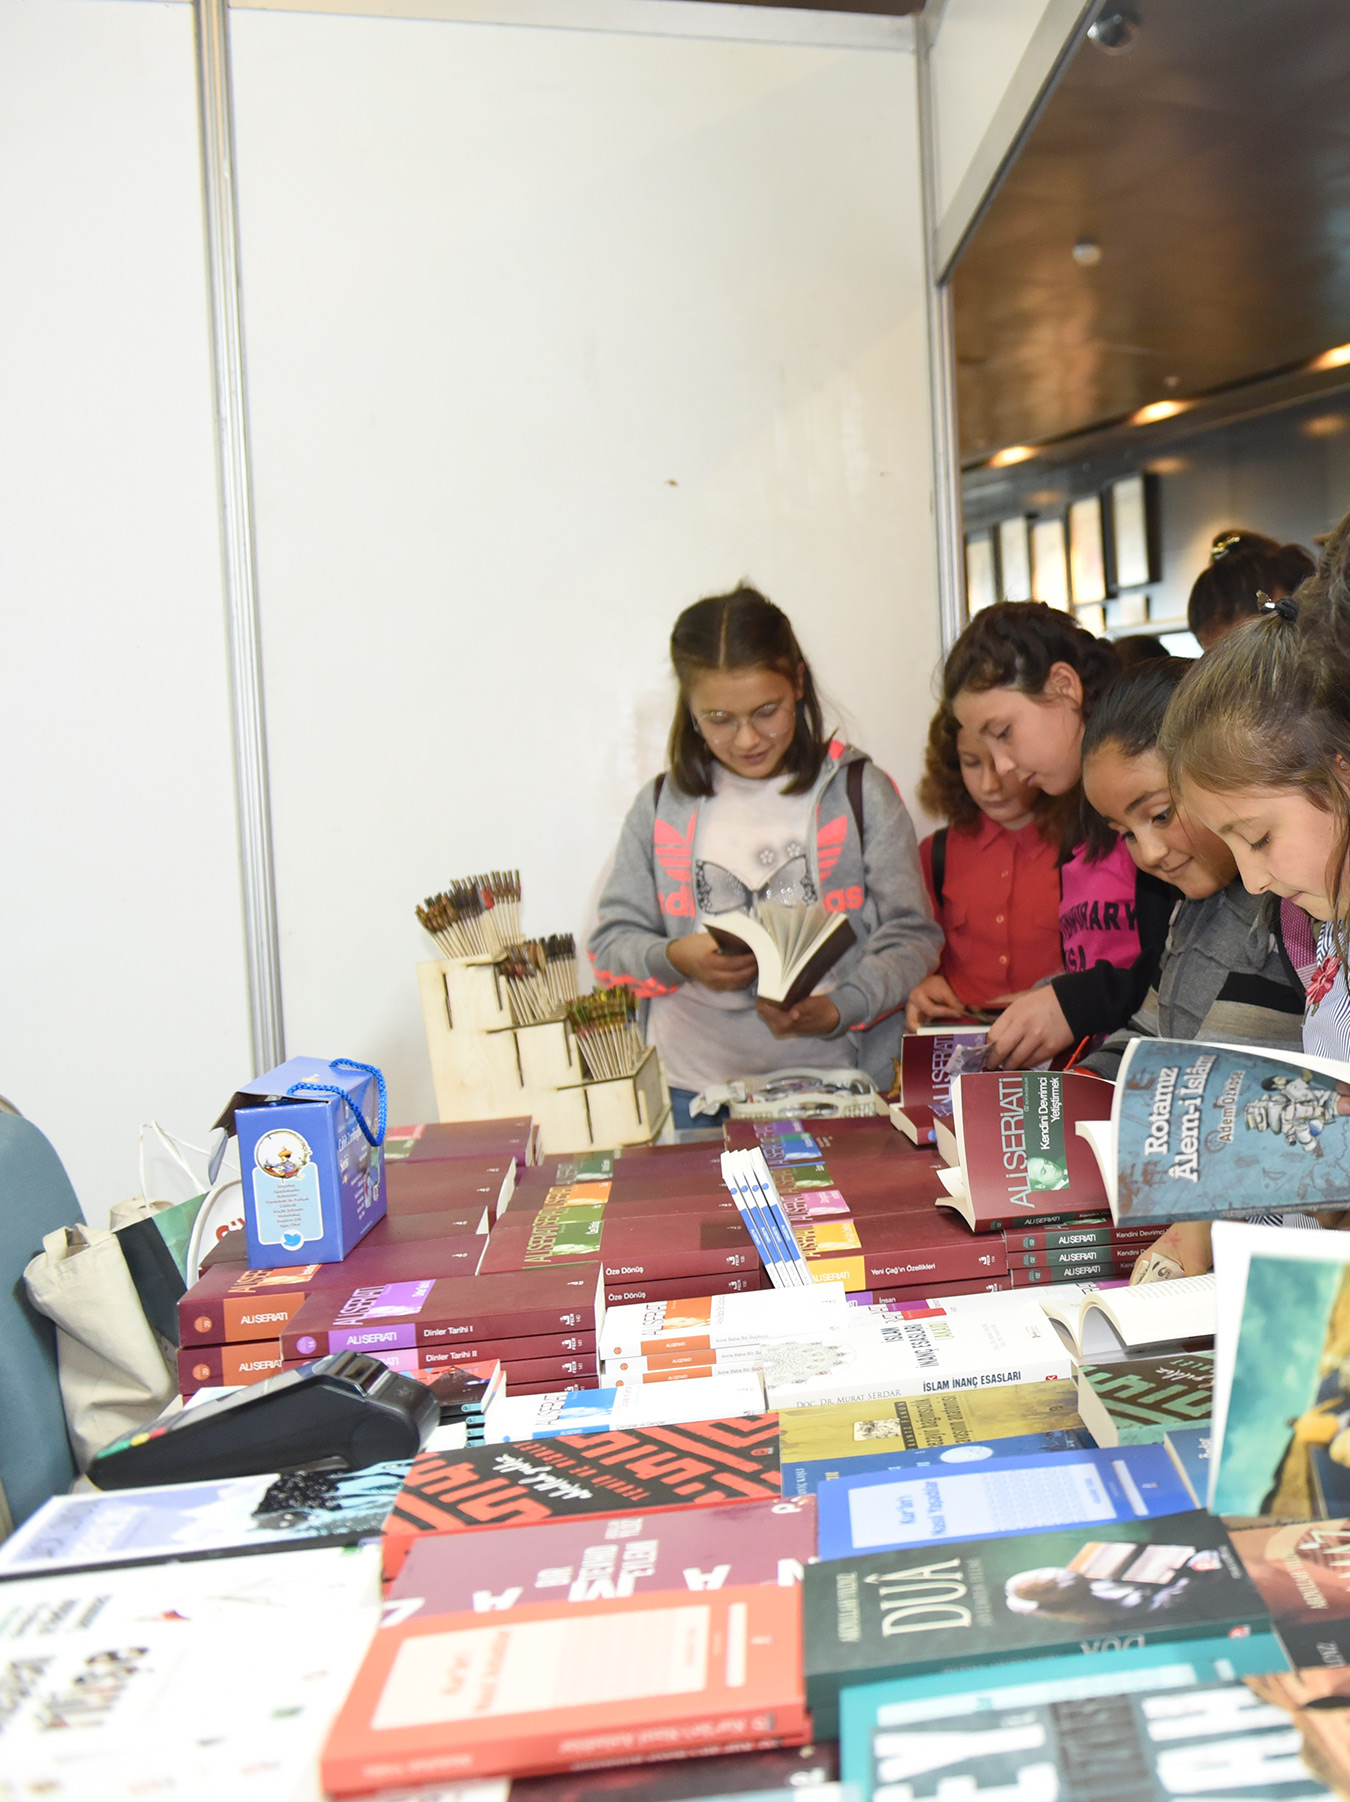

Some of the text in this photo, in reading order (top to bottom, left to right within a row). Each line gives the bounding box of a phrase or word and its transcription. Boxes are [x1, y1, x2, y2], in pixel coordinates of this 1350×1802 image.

[1051, 1076, 1063, 1123] Yetiştirmek
[1038, 1076, 1051, 1150] Kendini Devrimci
[1144, 1066, 1180, 1156] Rotamız
[1216, 1106, 1236, 1144] Adem
[1116, 1230, 1138, 1239] Kendini
[1117, 1248, 1139, 1257] Kendini
[605, 1266, 619, 1276] Öze
[620, 1266, 644, 1276] Dönüş
[871, 1267, 884, 1277] Yeni
[906, 1262, 936, 1273] Özellikleri
[608, 1292, 621, 1302] Öze
[623, 1291, 646, 1301] Dönüş
[423, 1327, 447, 1338] Dinler
[447, 1325, 469, 1335] Tarihi
[425, 1353, 449, 1363] Dinler
[450, 1350, 471, 1361] Tarihi
[867, 1388, 901, 1400] SERDAR
[923, 1379, 950, 1393] İSLAM
[952, 1376, 978, 1390] İNANÇ
[980, 1371, 1022, 1386] ESASLARI
